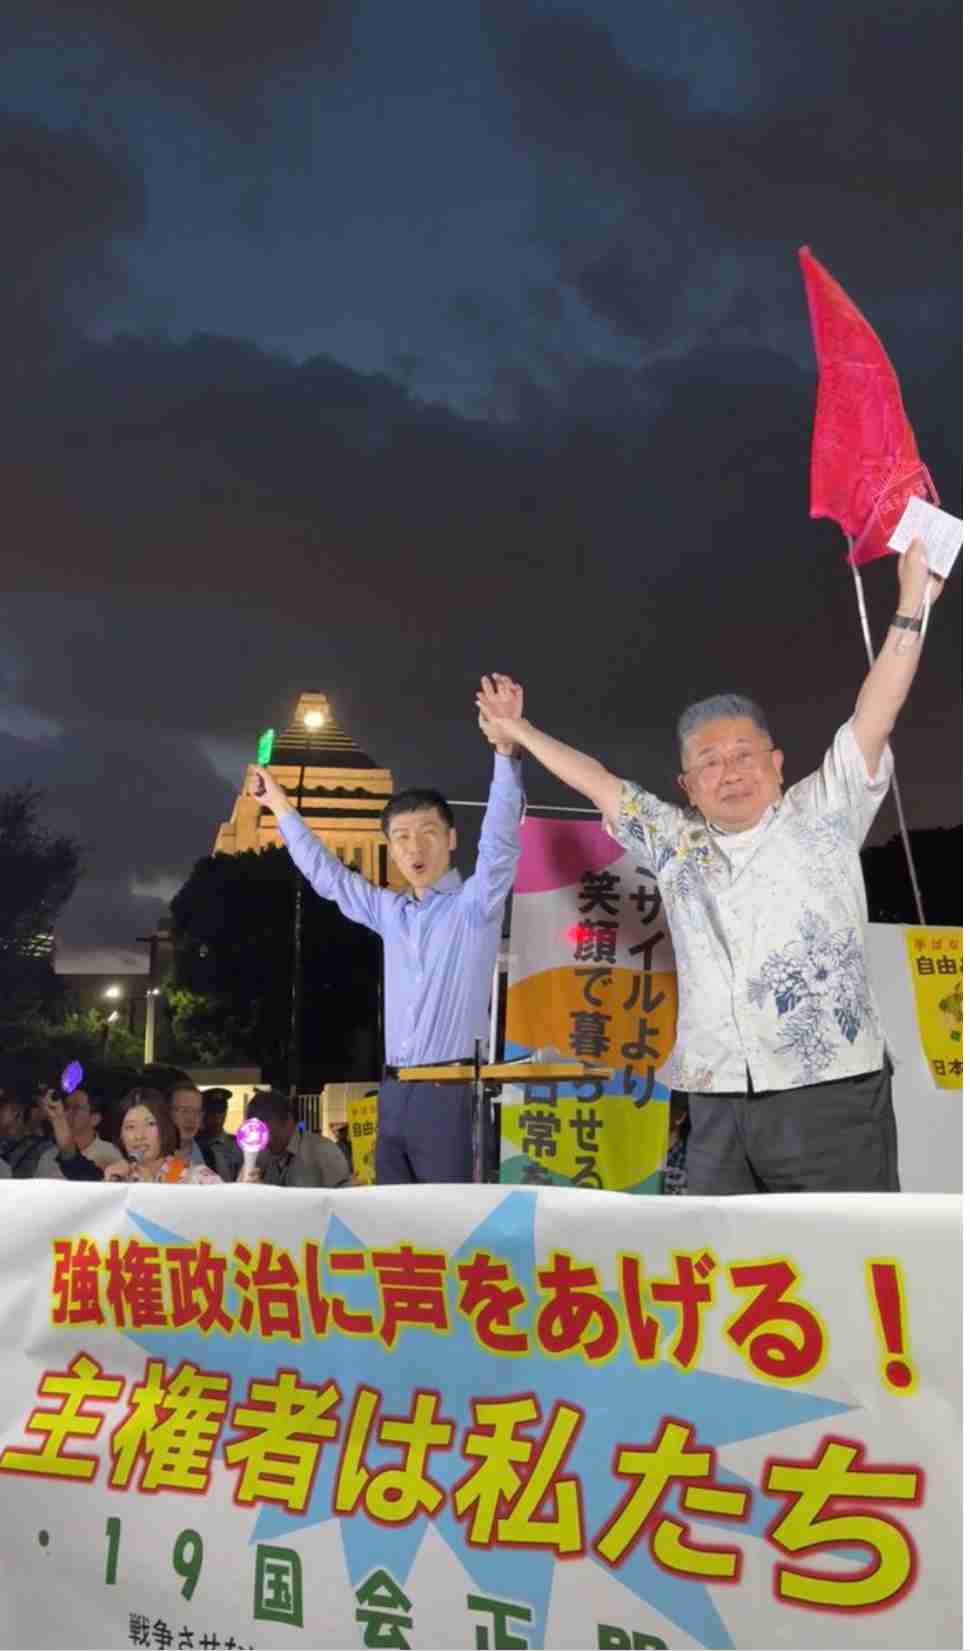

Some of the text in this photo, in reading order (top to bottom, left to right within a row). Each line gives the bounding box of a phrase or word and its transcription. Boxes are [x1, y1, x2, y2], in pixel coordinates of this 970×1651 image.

[915, 955, 963, 976] 自由
[50, 1236, 915, 1391] 強権政治に声をあげる！
[0, 1351, 924, 1613] 主権者は私たち
